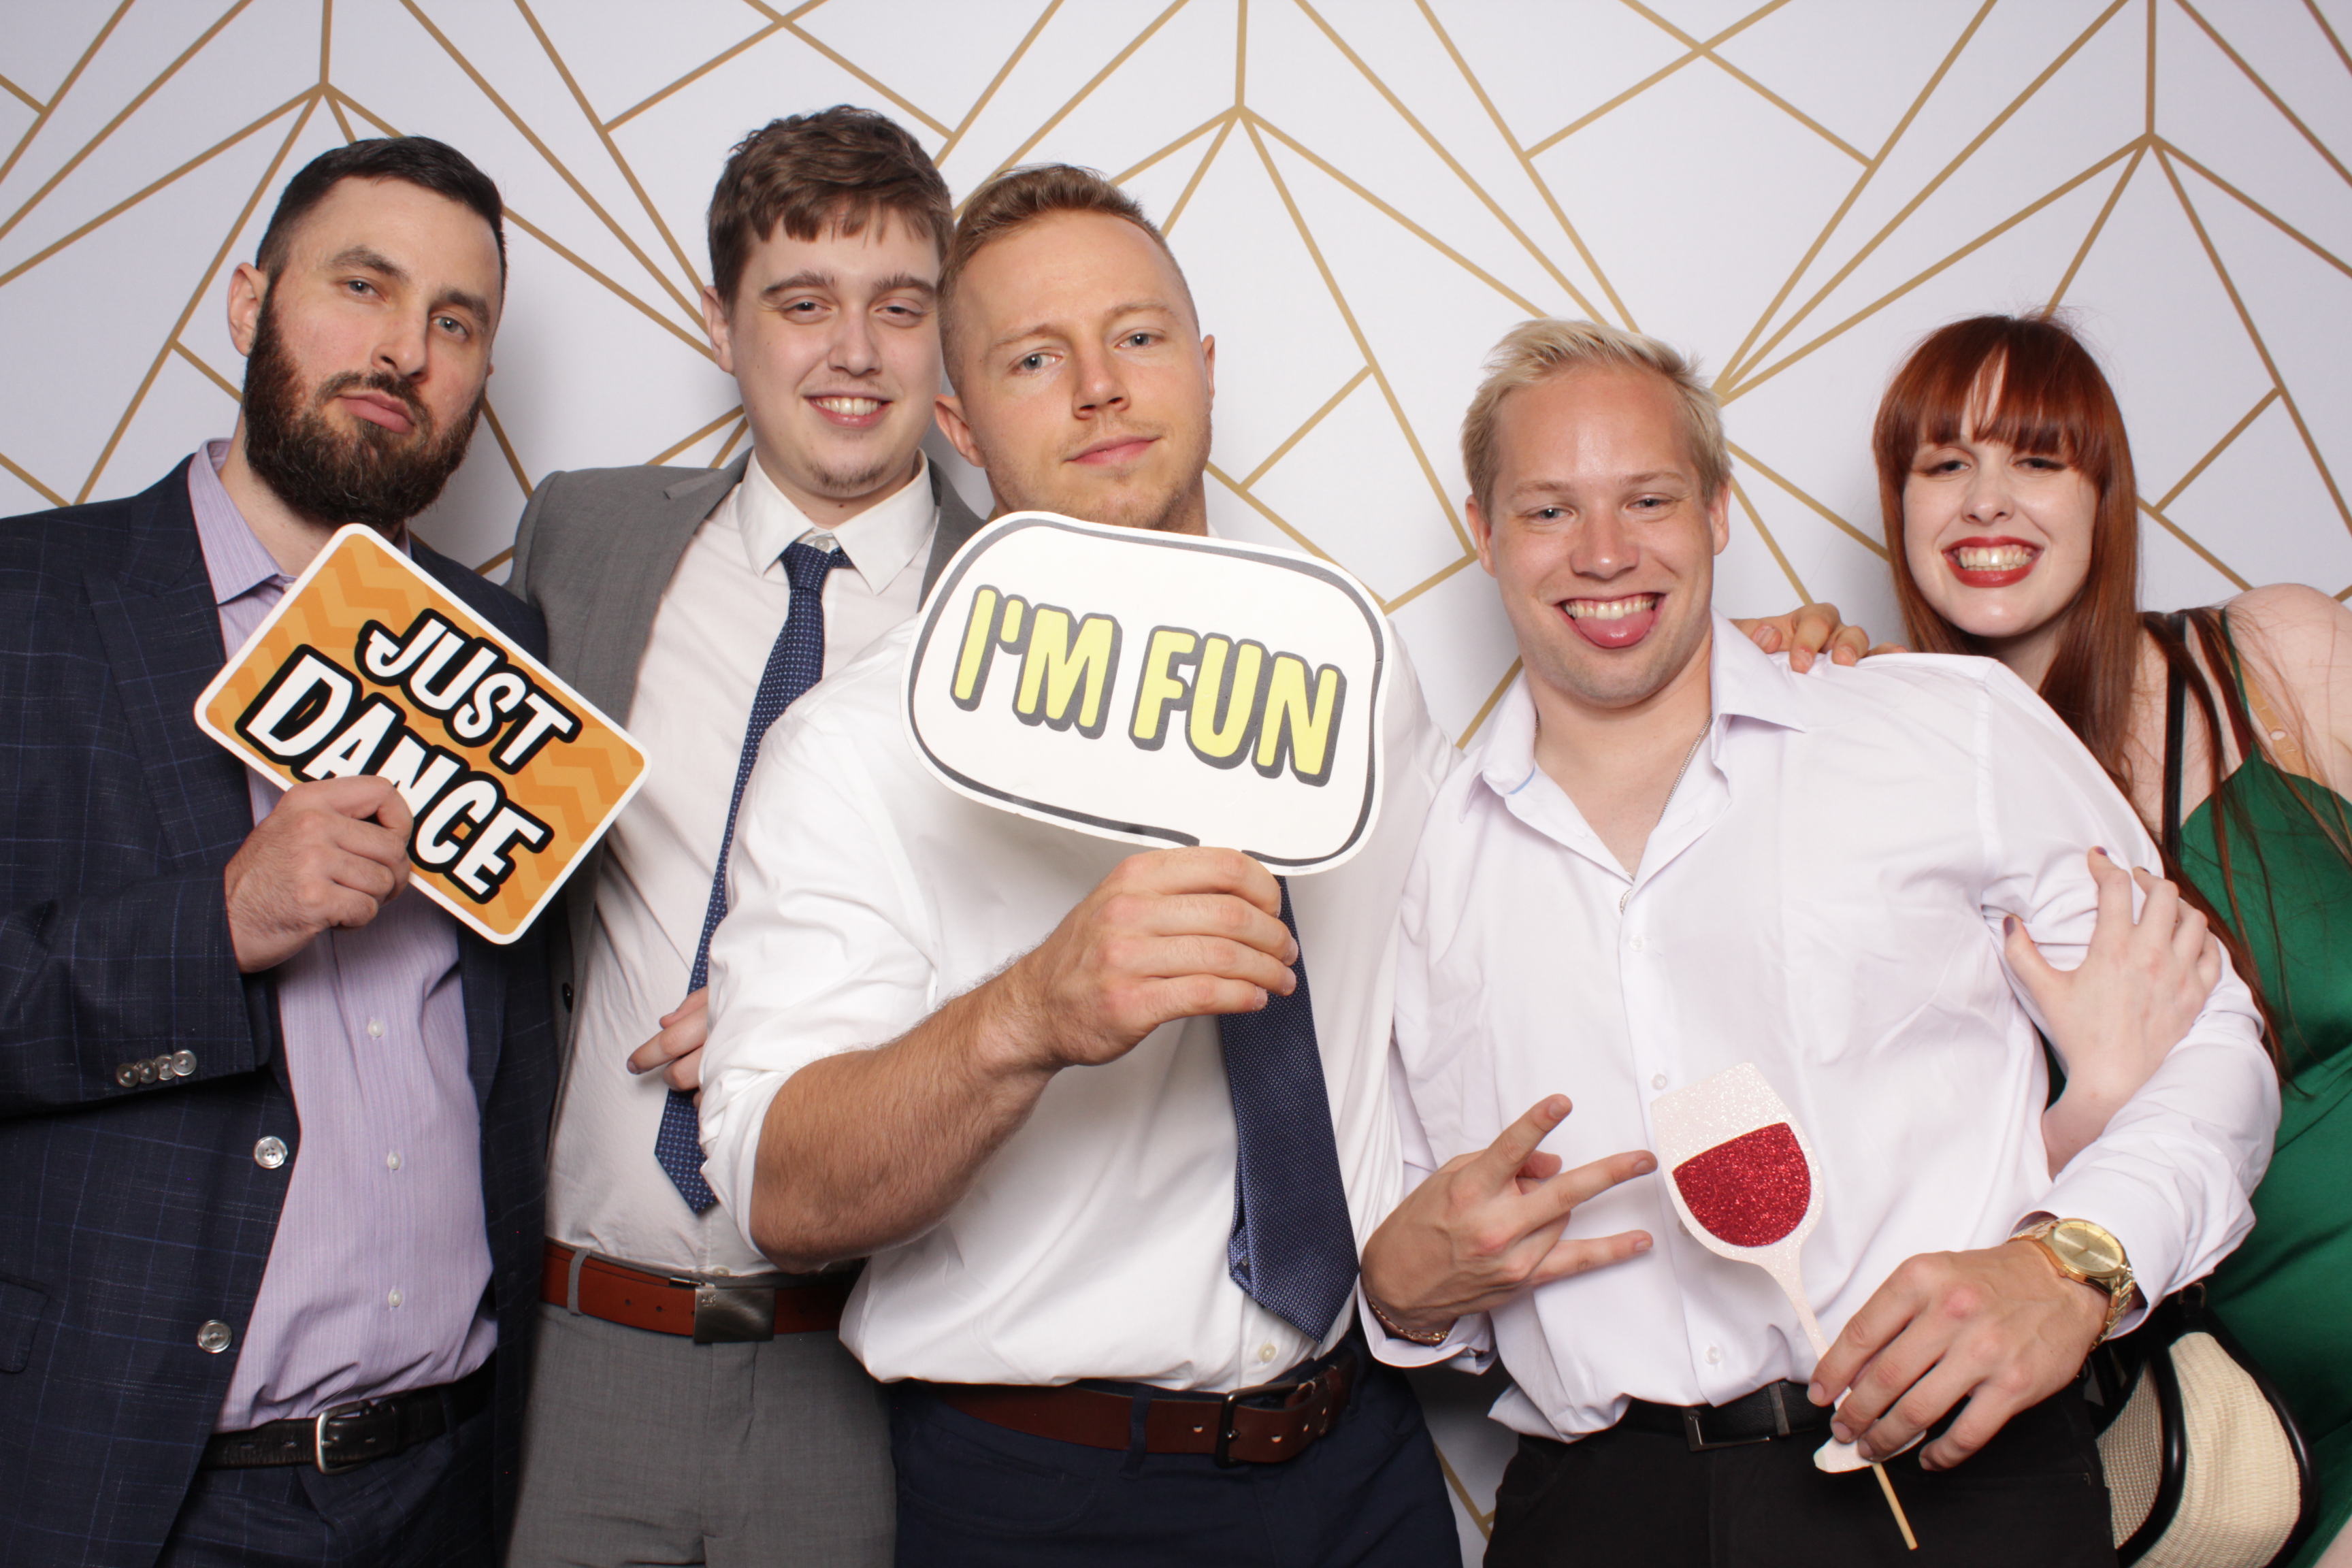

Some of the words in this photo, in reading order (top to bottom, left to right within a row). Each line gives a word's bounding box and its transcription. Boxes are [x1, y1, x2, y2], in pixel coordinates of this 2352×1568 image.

[242, 650, 549, 898] DANCE
[361, 615, 577, 769] JUST
[953, 587, 1120, 735] I'M
[1130, 627, 1343, 783] FUN
